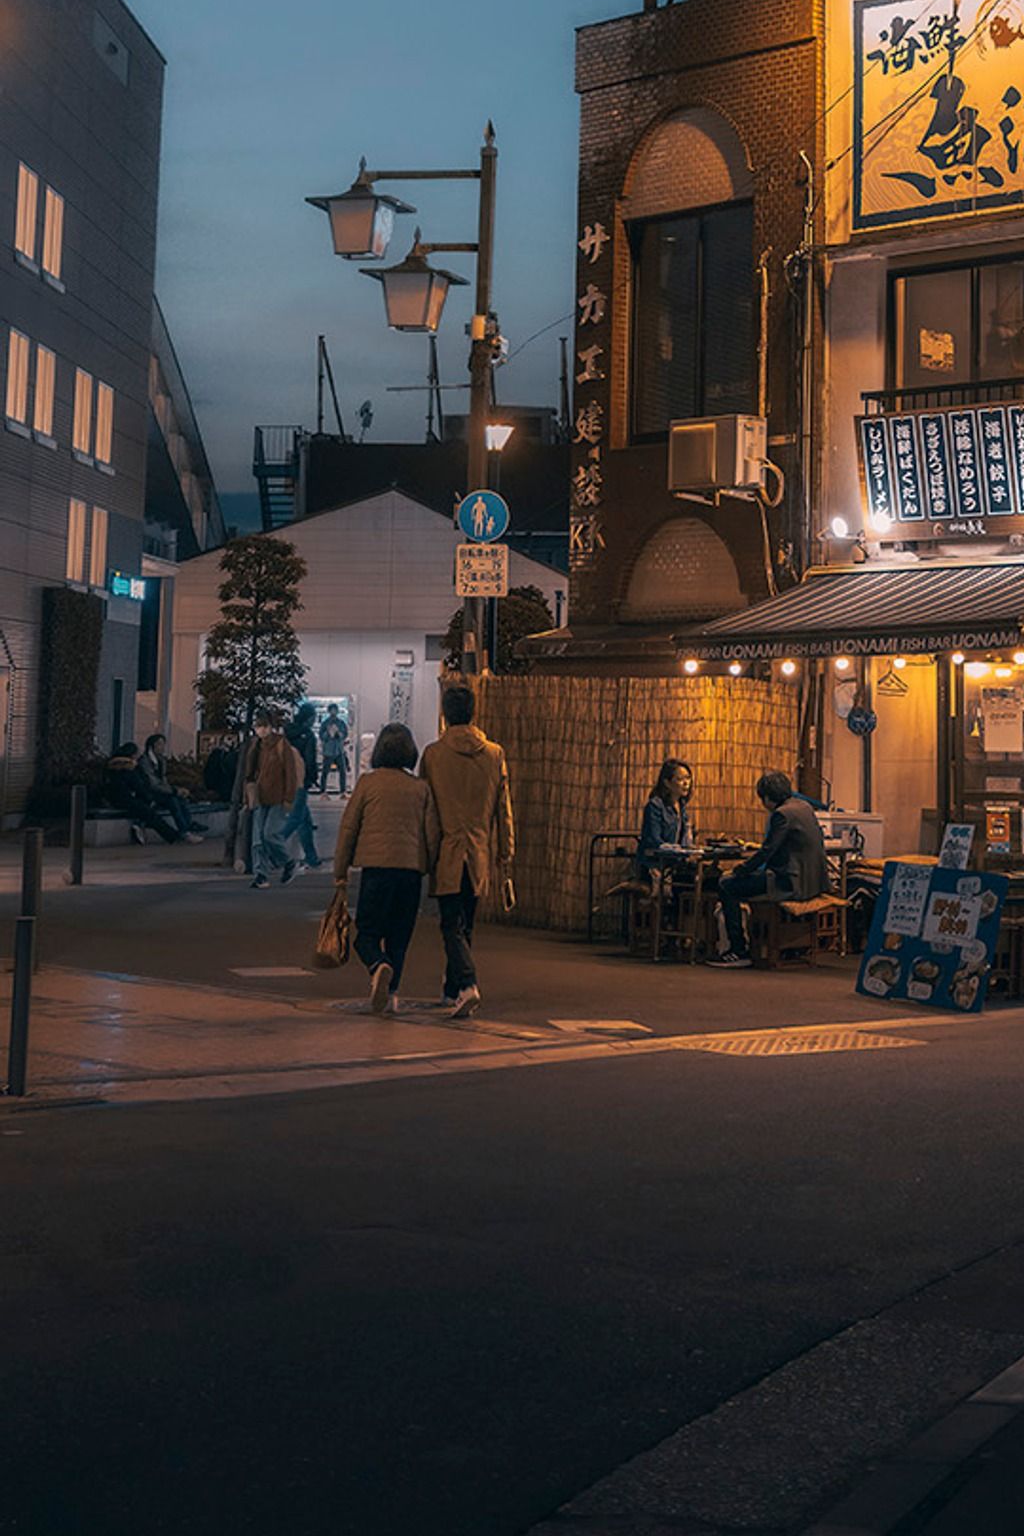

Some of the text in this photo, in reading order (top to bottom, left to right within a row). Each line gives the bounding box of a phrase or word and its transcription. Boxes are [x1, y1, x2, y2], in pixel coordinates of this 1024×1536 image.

[722, 644, 784, 659] UONAMI
[785, 644, 807, 655] FISH
[810, 642, 832, 654] BAR
[832, 638, 899, 654] UONAMI
[902, 636, 925, 650] FISH
[928, 636, 950, 649] BAR
[950, 631, 1019, 648] UONAMI
